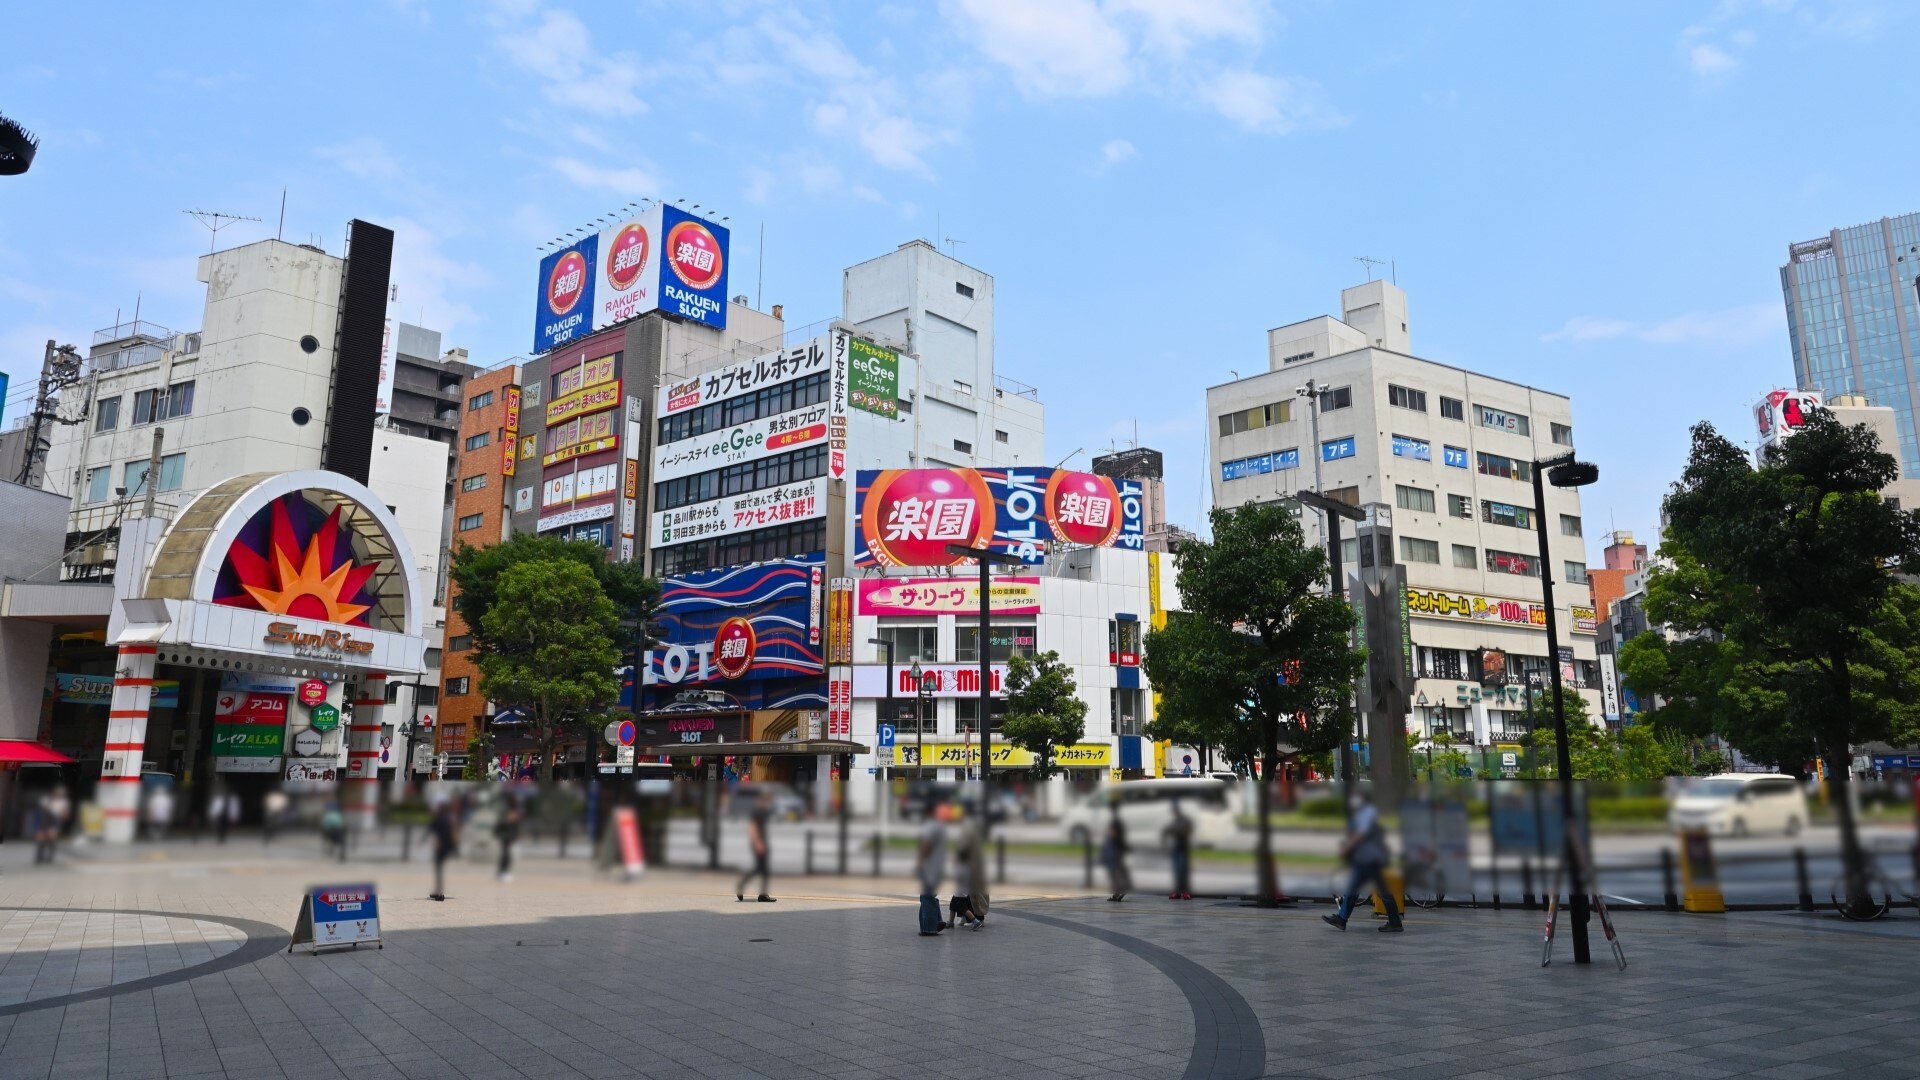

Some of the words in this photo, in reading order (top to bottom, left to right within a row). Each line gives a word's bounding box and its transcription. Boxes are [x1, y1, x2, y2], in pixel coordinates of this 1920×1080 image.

[614, 242, 643, 273] 楽園
[677, 242, 715, 272] 楽園
[553, 268, 581, 299] 楽園
[669, 256, 689, 285] EXCITING
[690, 273, 720, 290] AMUSEMENT
[605, 288, 646, 313] RAKUEN
[665, 285, 720, 314] RAKUEN
[614, 305, 635, 321] SLOT
[679, 302, 707, 321] SLOT
[545, 312, 582, 337] RAKUEN
[553, 328, 572, 344] SLOT
[852, 341, 896, 362] カプセルホテル
[561, 361, 613, 391] カラオケ
[705, 344, 825, 400] カプセルホテル
[834, 334, 845, 414] カプセルホテル
[853, 357, 895, 381] eeGee
[865, 373, 883, 384] STAY
[858, 379, 890, 395] イージーステイ
[552, 399, 576, 415] カラオケ
[503, 393, 520, 472] カラオケ
[558, 415, 609, 448] カラオケ
[768, 408, 826, 435] 男女別フロア
[660, 445, 710, 469] イージーステイ
[712, 428, 763, 456] eeGee
[727, 451, 746, 463] STAY
[1328, 443, 1348, 457] 7F
[1447, 451, 1462, 463] 7F
[564, 474, 605, 491] ホトヨガ
[673, 505, 719, 525] 品川駅からも
[733, 496, 815, 528] アクセス抜群!!
[884, 496, 976, 541] 楽園
[1006, 470, 1037, 562] SLOT
[1058, 491, 1112, 528] 楽園
[1123, 482, 1141, 549] SLOT
[673, 519, 727, 540] 羽田空港からも
[900, 587, 966, 606] ザ・リーヴ
[1408, 590, 1471, 617] ネットルーム
[263, 621, 375, 653] SunRise
[720, 637, 748, 660] 楽園
[830, 680, 838, 703] mini
[841, 680, 850, 703] mini
[251, 699, 283, 711] アコム
[318, 709, 334, 717] レイク
[245, 716, 256, 724] 3F
[669, 718, 714, 731] RAKUEN
[829, 711, 838, 734] mini
[840, 711, 849, 734] mini
[681, 732, 701, 743] SLOT
[883, 727, 892, 744] P
[1061, 749, 1105, 760] メガネドラッグ
